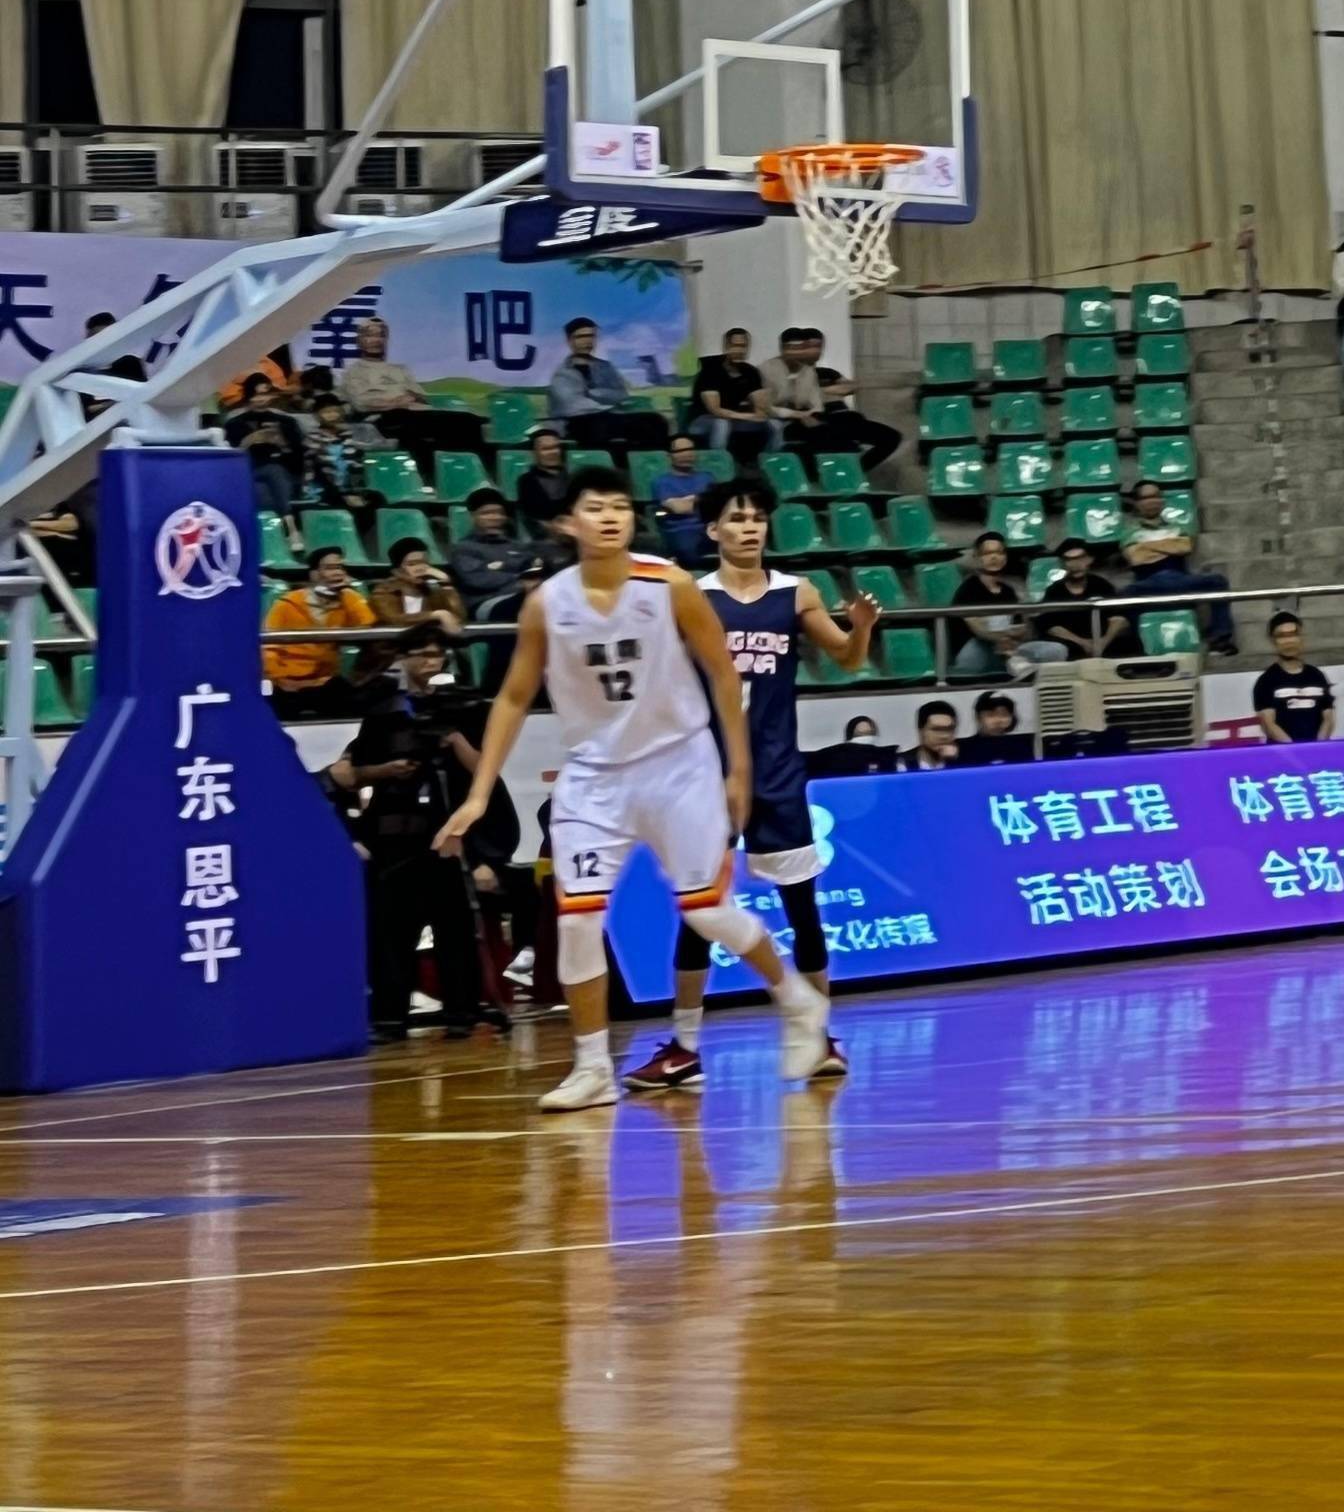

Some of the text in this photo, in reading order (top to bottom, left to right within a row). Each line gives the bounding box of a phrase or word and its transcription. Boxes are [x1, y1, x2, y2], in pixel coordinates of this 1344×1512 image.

[598, 669, 636, 702] 12
[173, 683, 242, 984] 广东恩平
[988, 782, 1180, 846] 体育工程
[572, 851, 600, 878] 12
[735, 888, 866, 911] Feiang
[1018, 856, 1207, 926] 活动策划
